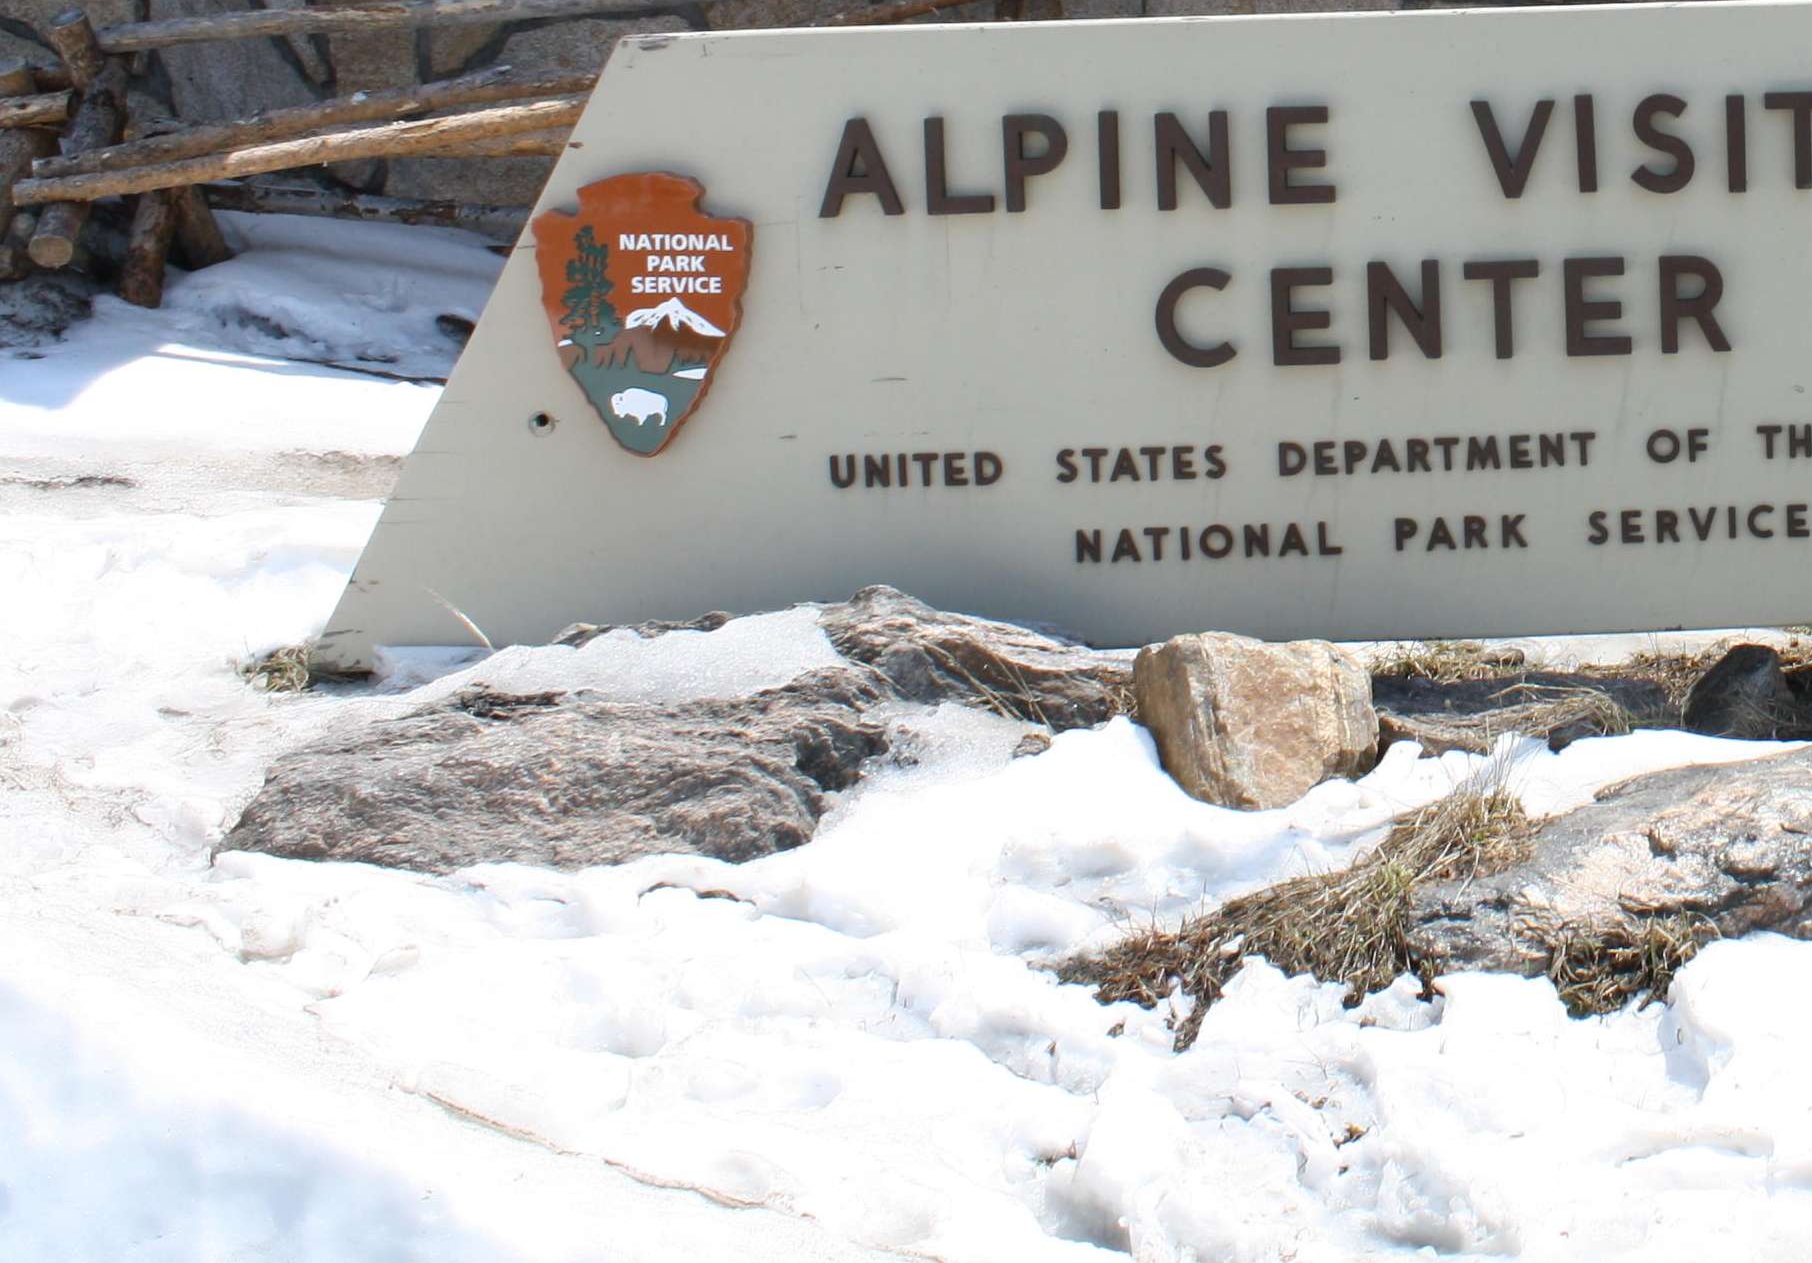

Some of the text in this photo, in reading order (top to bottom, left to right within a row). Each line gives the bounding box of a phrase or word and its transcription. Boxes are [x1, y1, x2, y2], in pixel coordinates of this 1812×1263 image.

[818, 104, 1339, 220] ALPINE
[619, 233, 734, 252] NATIONAL
[647, 255, 706, 273] PARK
[631, 276, 723, 294] SERVICE
[1153, 253, 1735, 370] CENTER
[829, 450, 1004, 490] UNITED
[1055, 444, 1228, 484] STATES
[1277, 430, 1597, 478] DEPARTMENT
[1645, 427, 1710, 464] OF
[1075, 503, 1812, 565] NATIONAL PARK SERVICE
